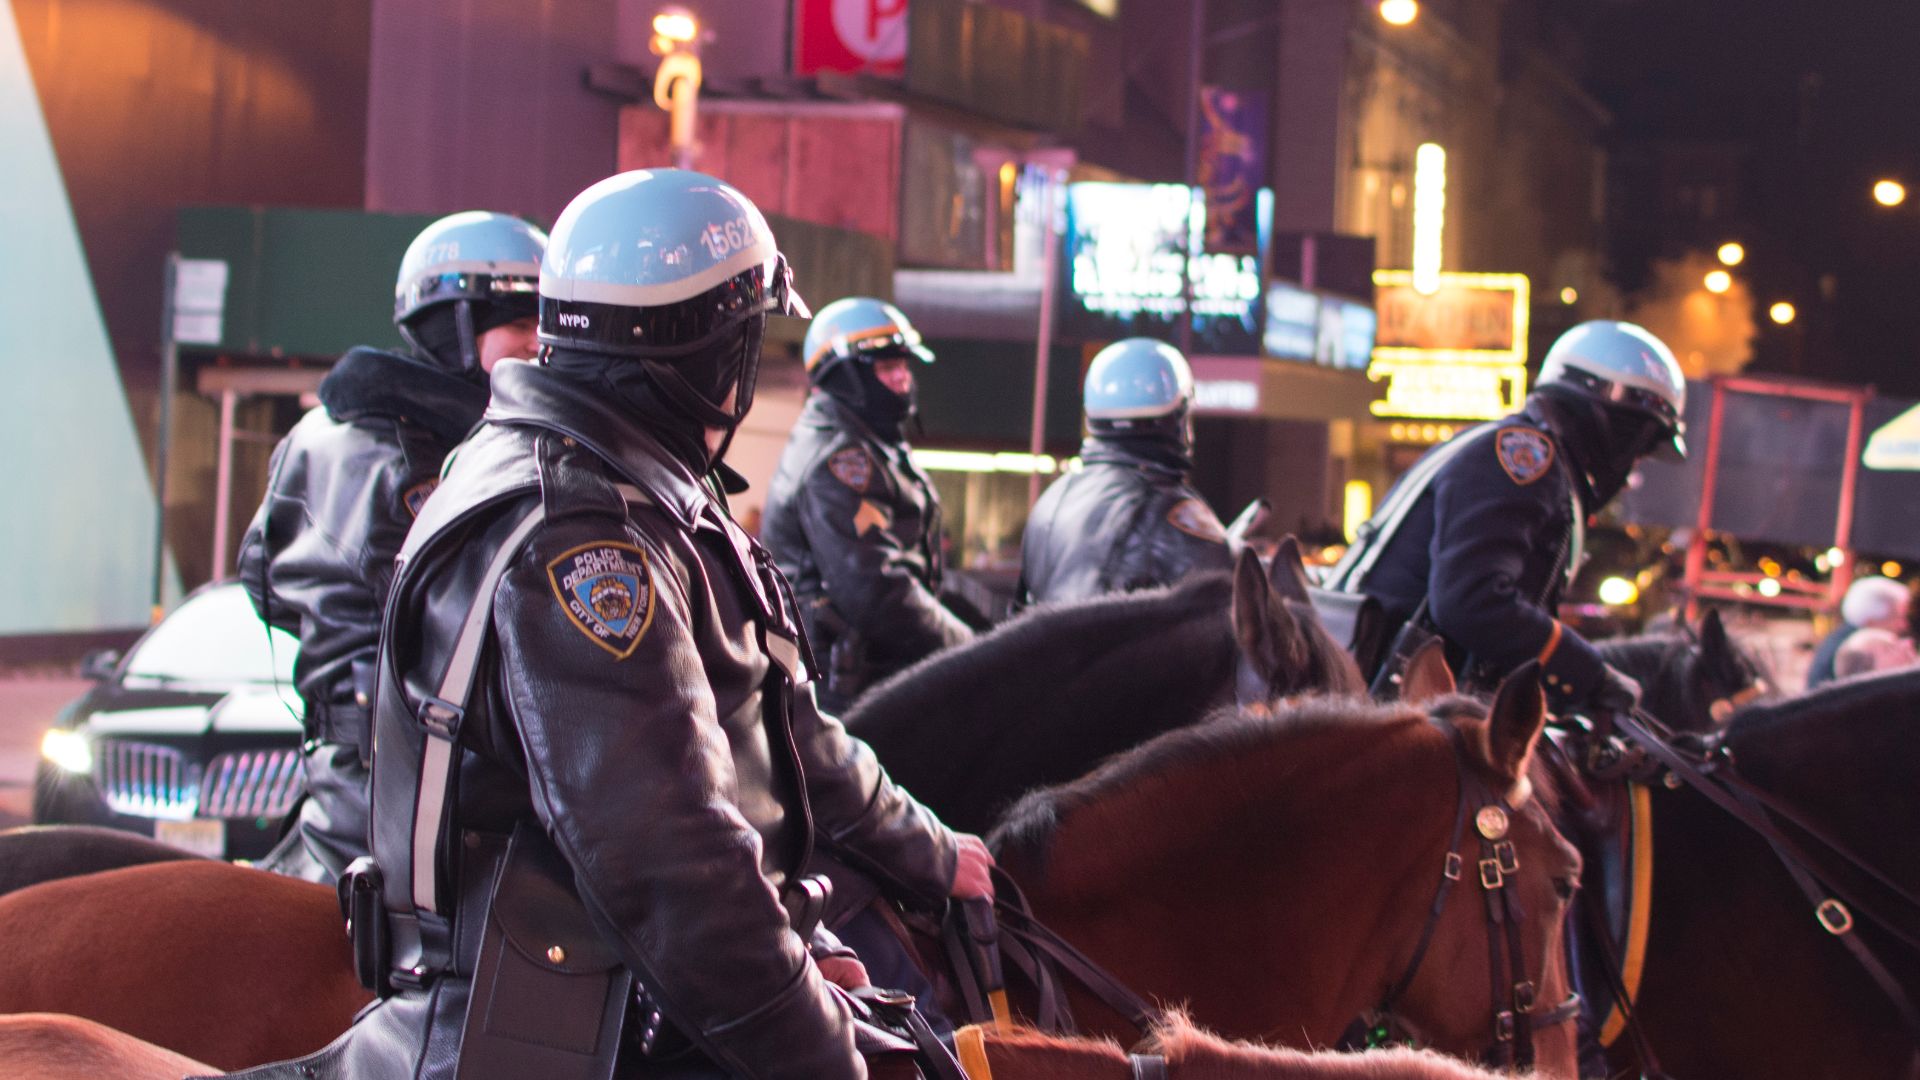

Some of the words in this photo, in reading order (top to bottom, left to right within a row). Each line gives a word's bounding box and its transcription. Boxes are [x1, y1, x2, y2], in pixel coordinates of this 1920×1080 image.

[701, 217, 757, 259] 1562
[559, 312, 590, 329] NYPD
[574, 548, 622, 568] POLICE
[563, 560, 643, 590] DEPARTMENT
[570, 600, 594, 625] CITY
[593, 623, 611, 638] OF
[626, 615, 642, 639] NEW
